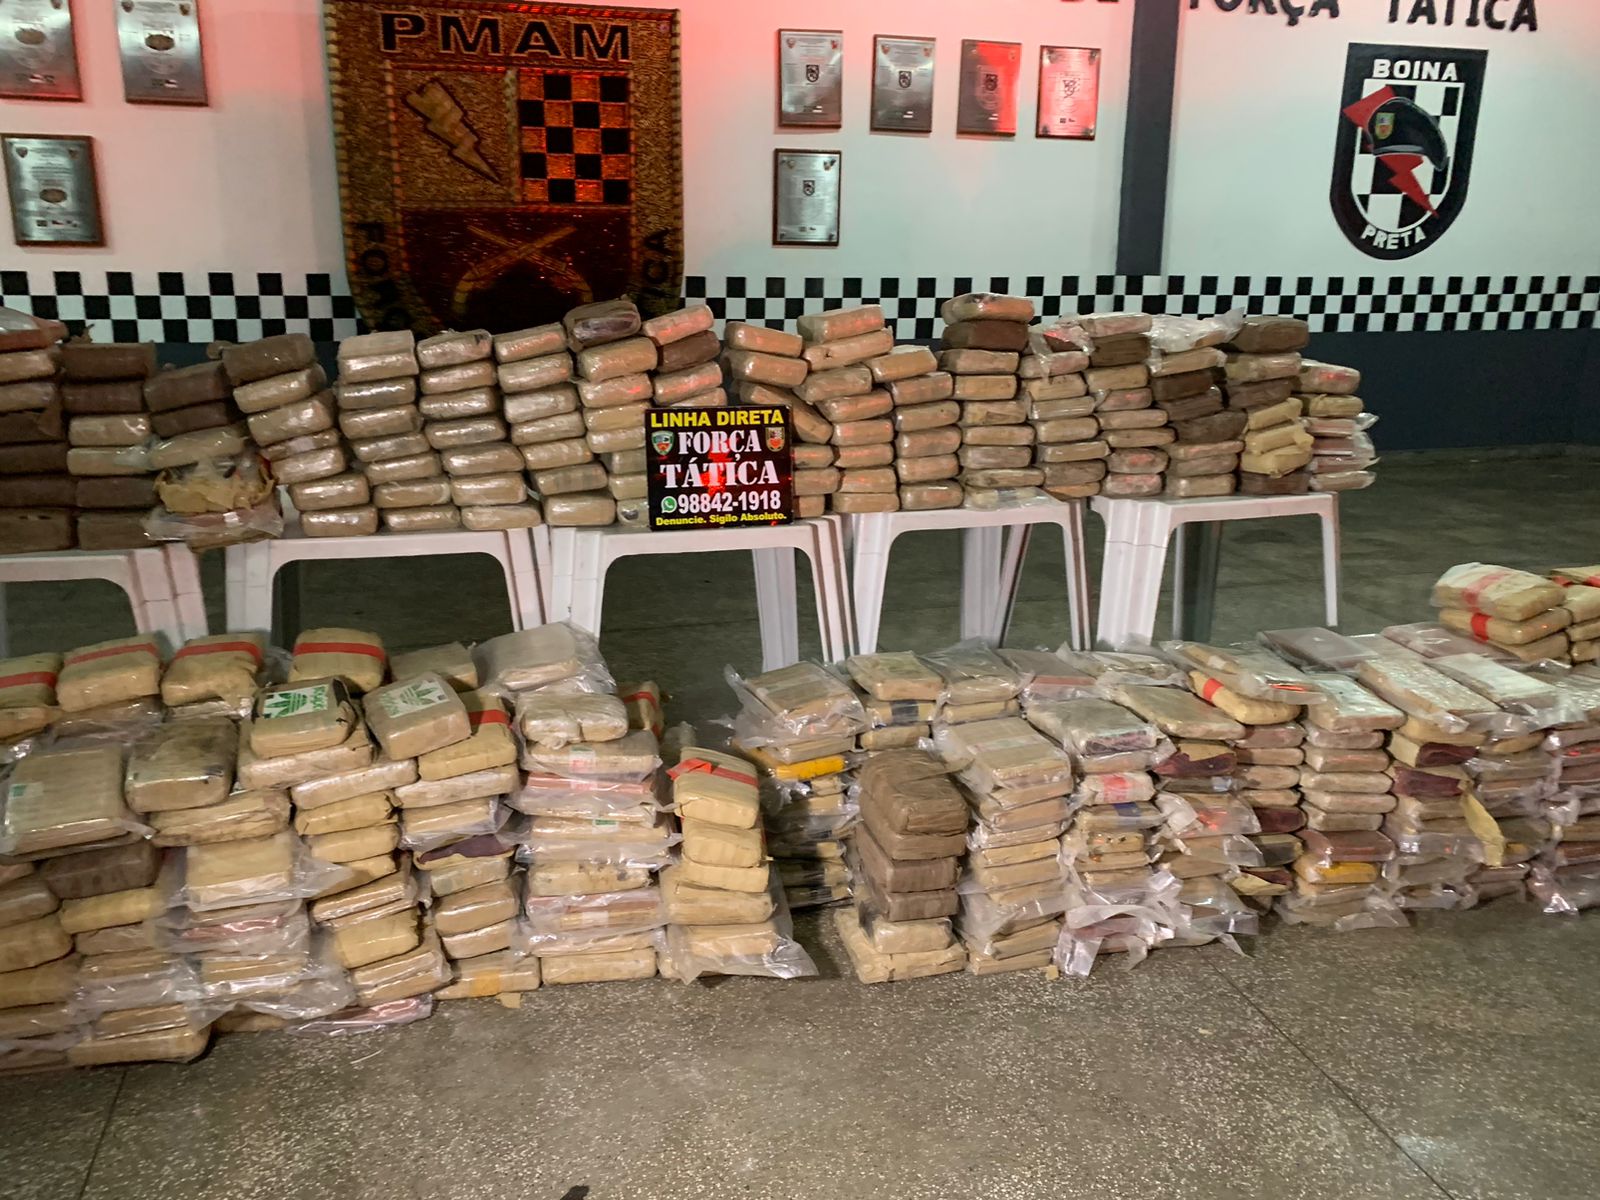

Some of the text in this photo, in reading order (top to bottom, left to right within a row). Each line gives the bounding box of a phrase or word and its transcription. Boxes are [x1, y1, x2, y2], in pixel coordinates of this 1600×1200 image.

[380, 11, 632, 61] PMAM
[1372, 58, 1458, 81] BOINA
[1361, 224, 1427, 250] PRETA
[650, 409, 785, 428] LINHA DIRETA
[677, 429, 762, 461] FORÇA
[659, 456, 780, 489] TÁTICA
[677, 489, 782, 514] 98842-1918
[655, 511, 787, 526] Denuncie. Sigilo Absoluto.
